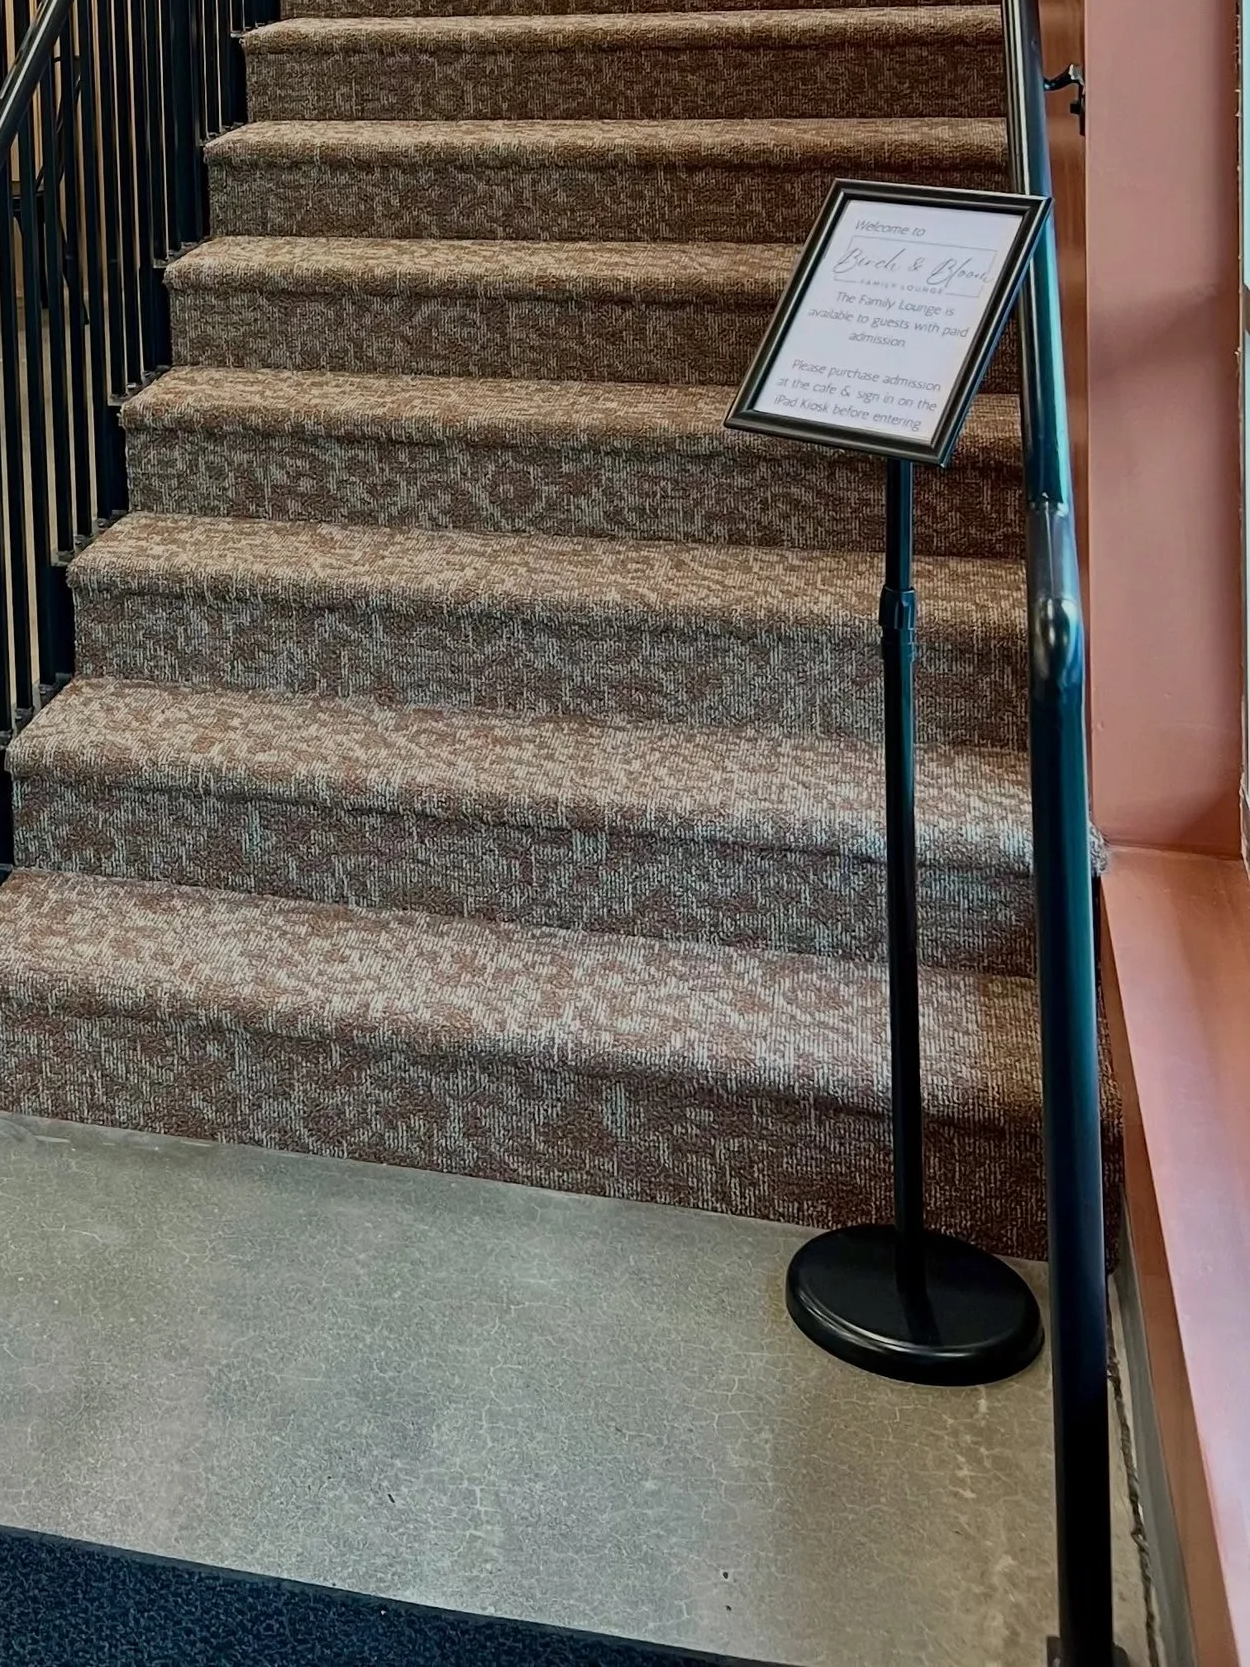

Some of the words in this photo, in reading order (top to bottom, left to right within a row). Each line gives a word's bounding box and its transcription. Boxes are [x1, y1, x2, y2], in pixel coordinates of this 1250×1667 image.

[855, 220, 909, 234] Welcome
[912, 226, 926, 237] to
[908, 257, 926, 272] &
[901, 284, 943, 294] LOUNGE
[836, 291, 855, 304] The
[858, 294, 895, 310] Family
[898, 299, 941, 316] Lounge
[945, 307, 956, 317] is
[808, 308, 854, 322] available
[857, 314, 869, 324] to
[871, 316, 910, 329] guests
[914, 322, 940, 333] with
[941, 326, 969, 338] paid
[849, 332, 906, 347] admission
[792, 359, 826, 374] Please
[827, 365, 880, 383] purchase
[882, 374, 941, 392] admission
[777, 377, 789, 387] at
[791, 379, 810, 390] the
[840, 385, 851, 397] &
[857, 390, 880, 404] sign
[883, 392, 894, 404] in
[897, 397, 914, 407] on
[916, 398, 937, 412] the
[774, 394, 798, 408] iPad
[800, 399, 829, 413] Kiosk
[832, 404, 870, 420] before
[873, 413, 922, 432] entering
